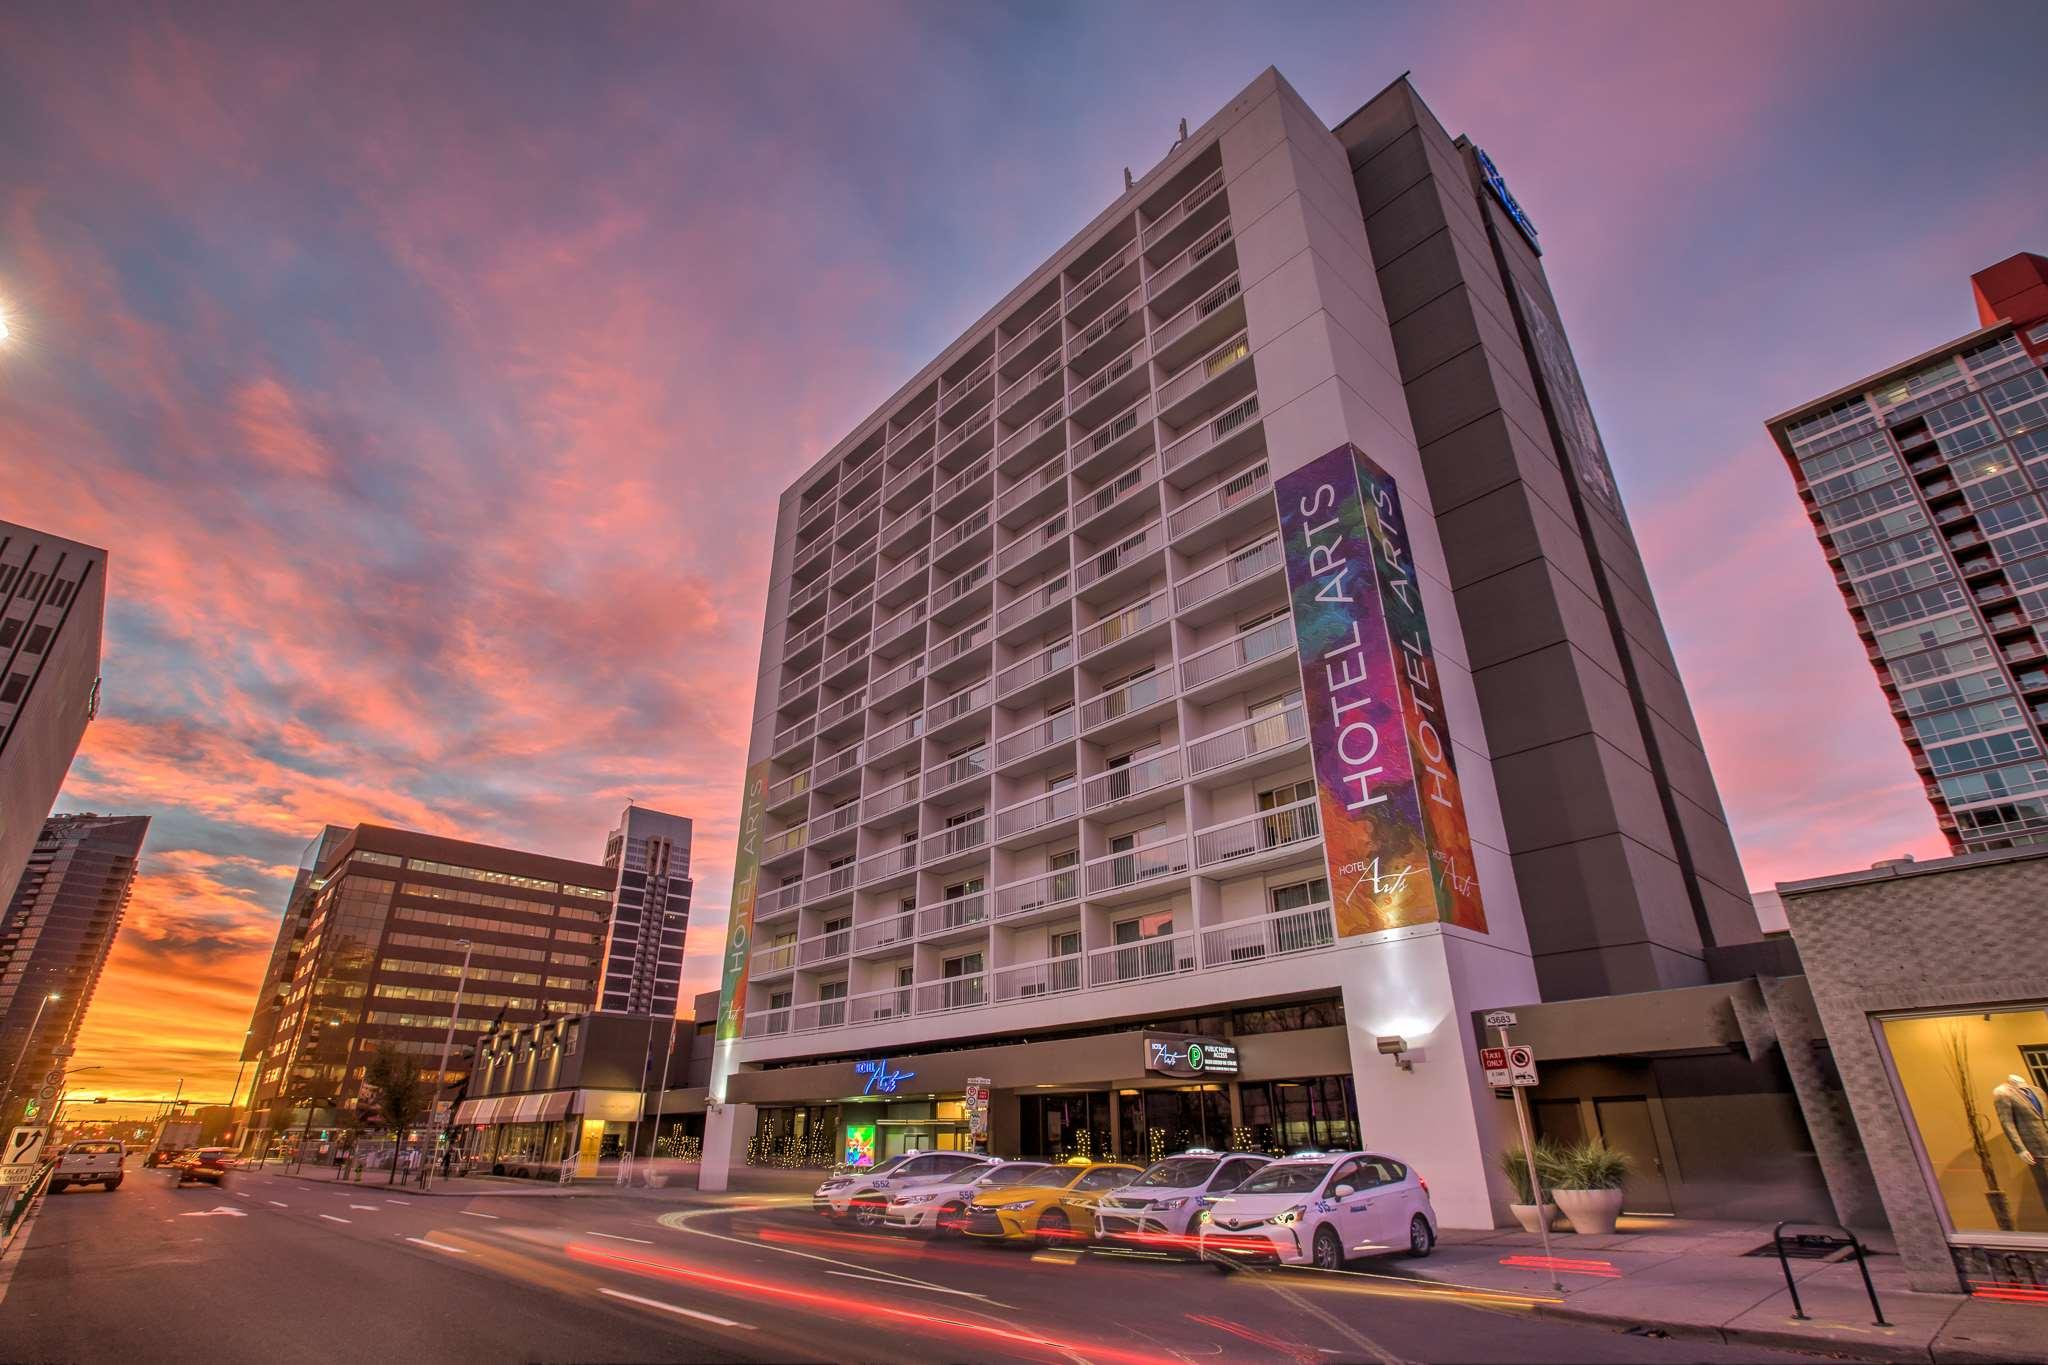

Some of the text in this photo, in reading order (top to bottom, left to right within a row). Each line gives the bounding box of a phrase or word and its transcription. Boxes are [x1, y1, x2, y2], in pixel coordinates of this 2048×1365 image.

[1300, 484, 1388, 810] HOTEL ARTS
[1371, 483, 1452, 808] HOTEL ARTS
[730, 778, 762, 973] HOTEL ARTS
[1338, 861, 1368, 876] HOTEL
[1486, 1059, 1503, 1067] ONLY
